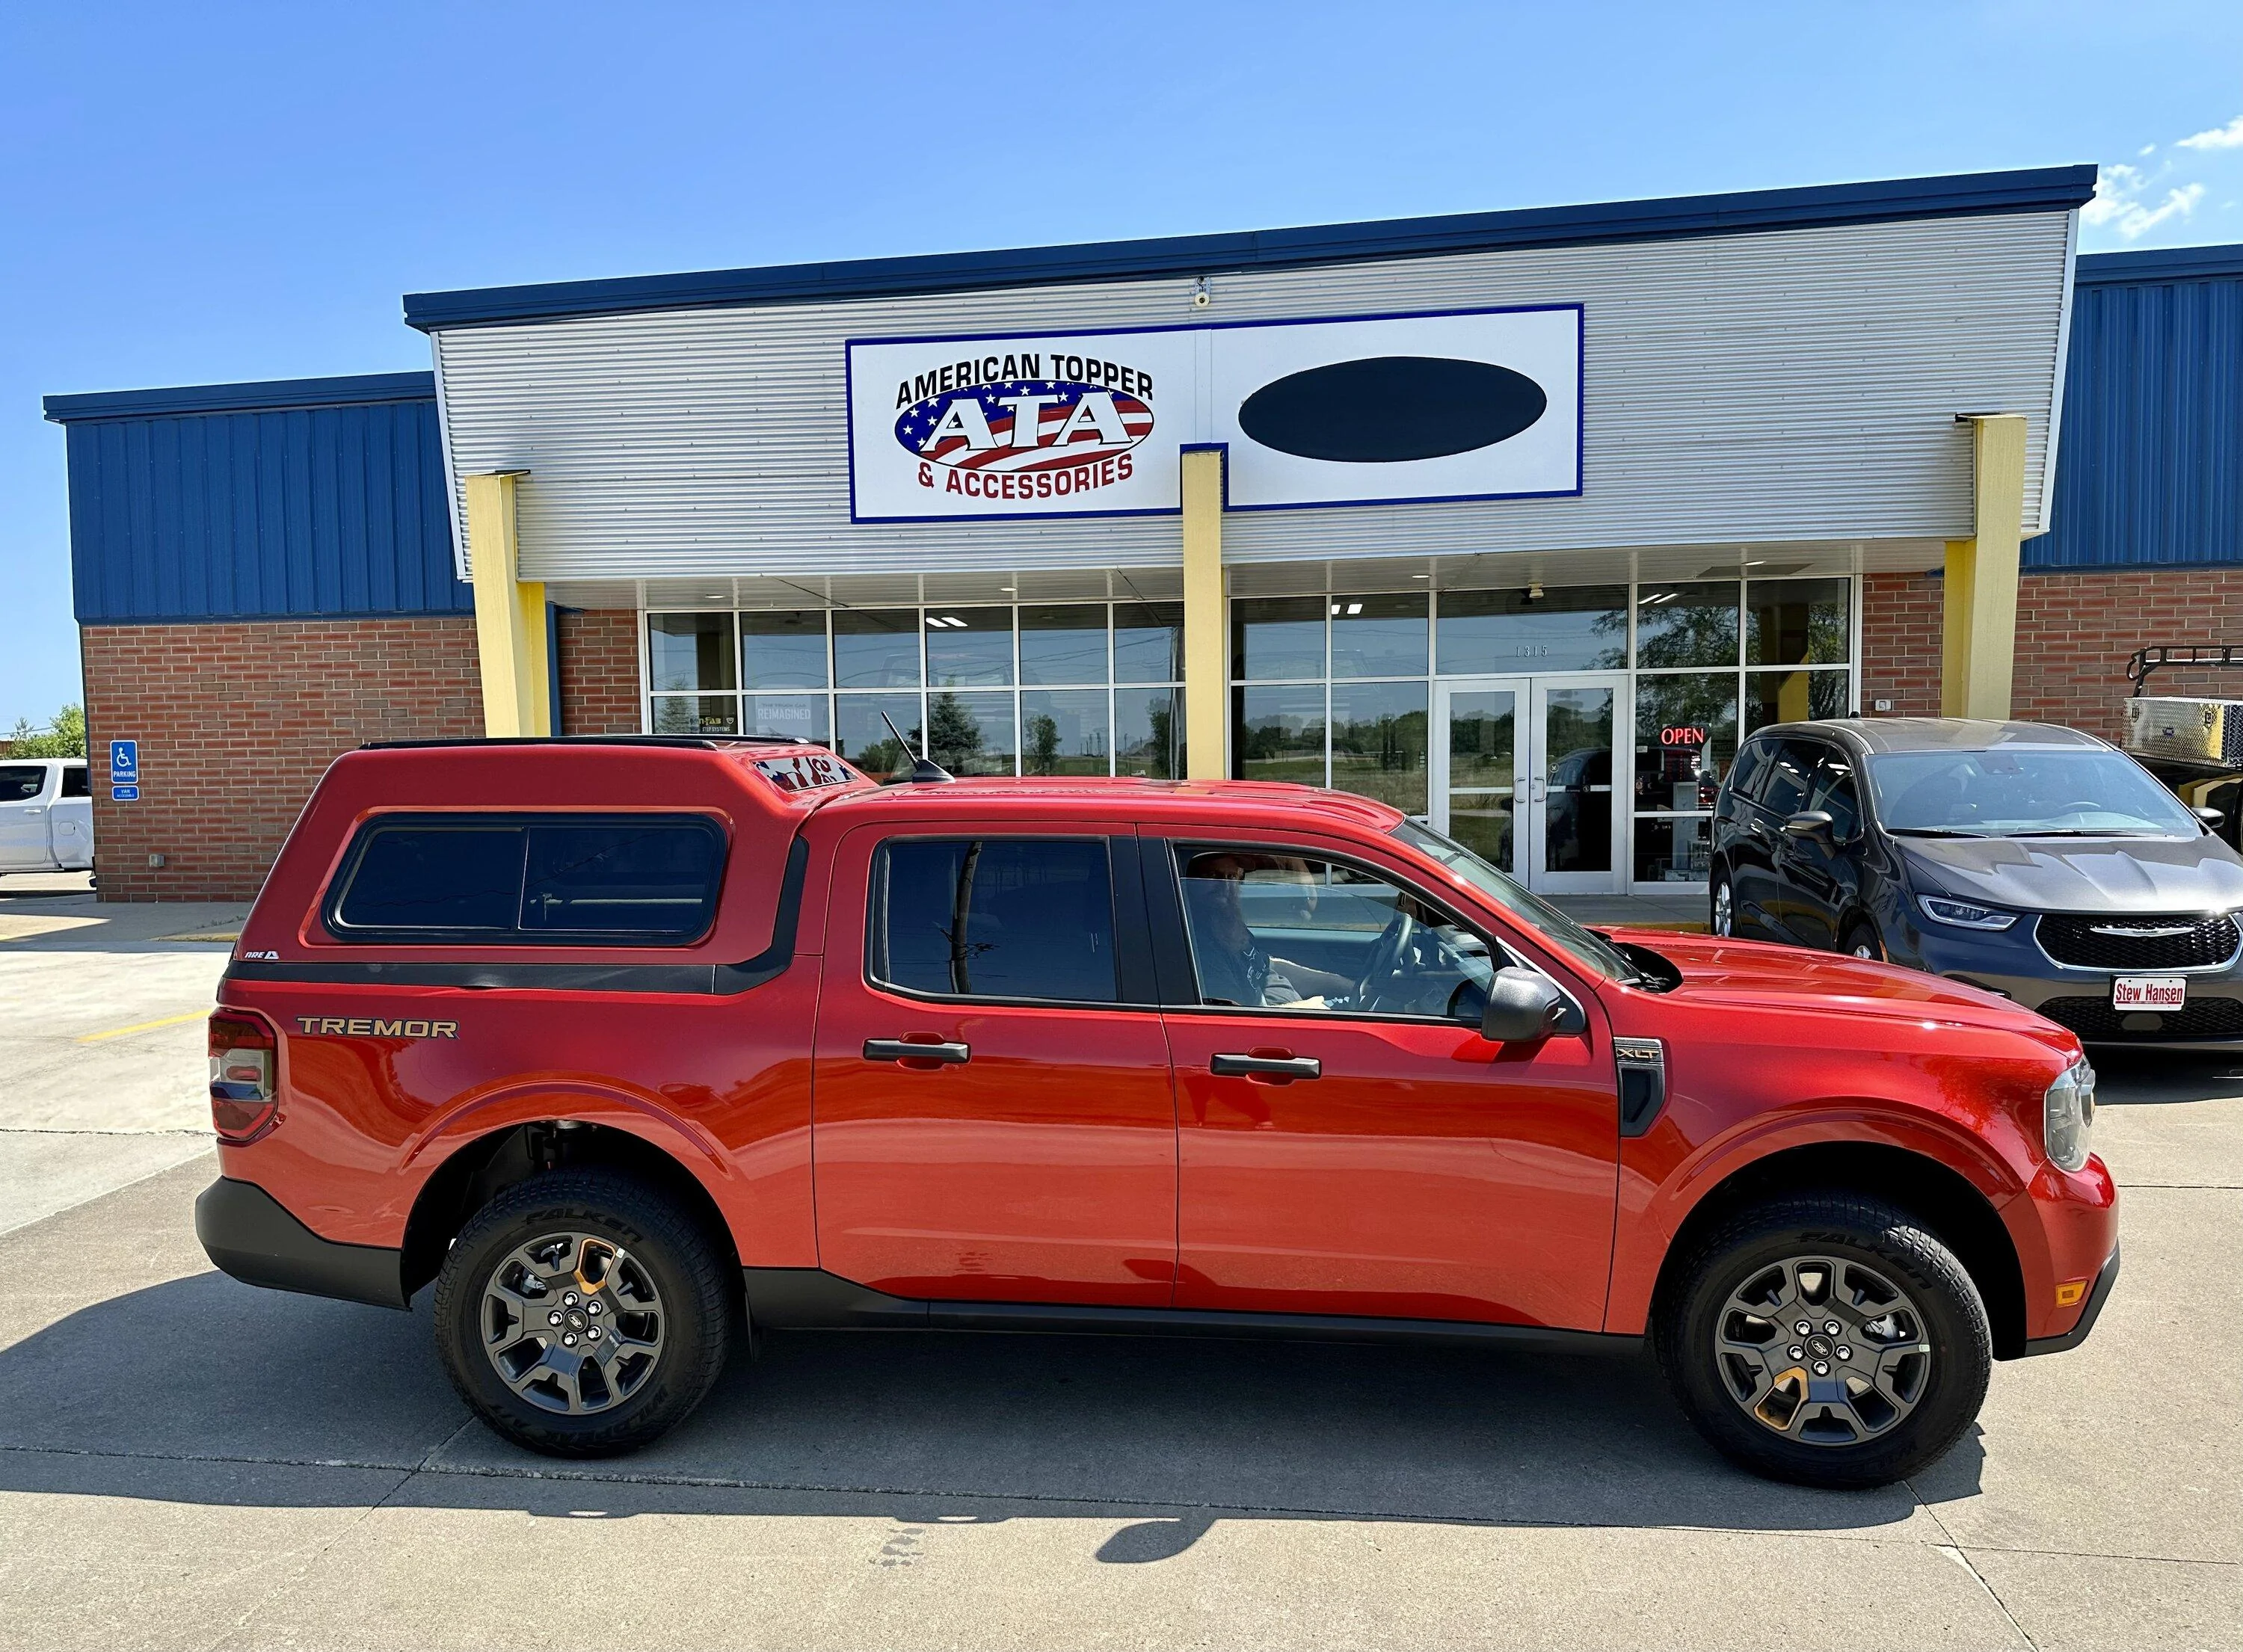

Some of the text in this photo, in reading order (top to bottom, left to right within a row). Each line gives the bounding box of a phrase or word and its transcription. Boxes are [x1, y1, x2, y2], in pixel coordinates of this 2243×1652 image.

[896, 354, 1153, 410] AMERICAN TOPPER
[920, 390, 1134, 452] ATA
[917, 453, 1133, 499] & ACCESSORIES
[1516, 645, 1548, 657] 1315
[757, 708, 810, 720] REIMAGINED
[1661, 728, 1704, 745] OPEN
[2116, 983, 2183, 1001] Stew Hansen
[296, 1016, 459, 1039] TREMOR
[1617, 1048, 1659, 1058] XLT
